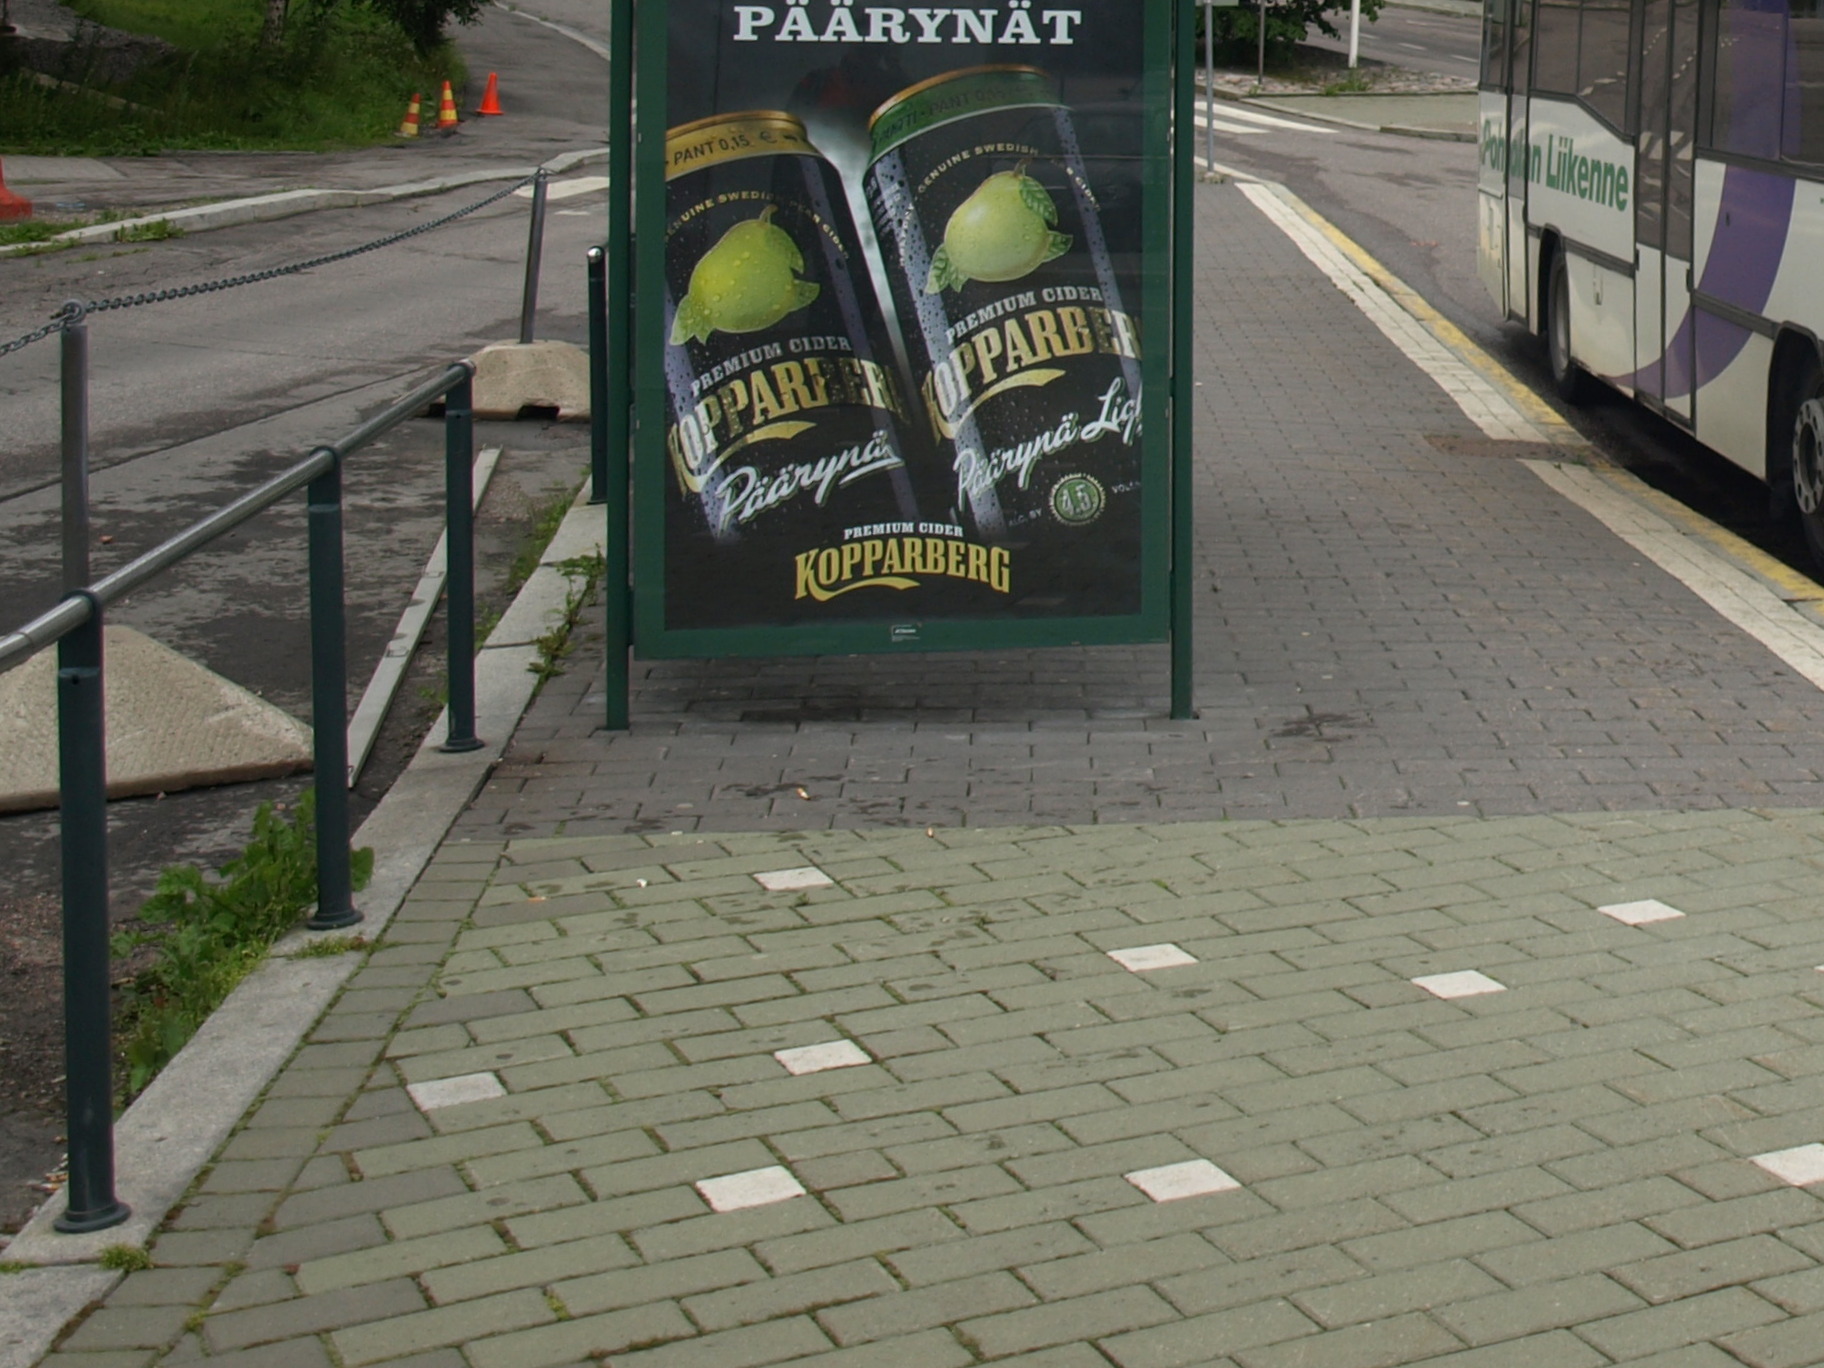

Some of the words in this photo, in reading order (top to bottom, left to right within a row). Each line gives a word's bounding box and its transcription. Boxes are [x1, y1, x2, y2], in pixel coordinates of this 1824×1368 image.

[674, 140, 715, 165] PANT
[918, 149, 971, 194] GENUINE
[974, 143, 1039, 156] SWEDISH
[1546, 134, 1629, 212] Liikenne
[717, 190, 784, 204] SWEDIS
[945, 290, 1037, 345] PREMIUM
[1041, 285, 1103, 303] CIDER
[691, 341, 783, 397] PREMIUM
[788, 335, 852, 354] CIDER
[714, 430, 904, 537] Päärynä
[953, 413, 1080, 512] Päärynä
[844, 522, 914, 540] PREMIUM
[919, 522, 963, 538] CIDER
[794, 537, 1010, 601] KOPPARBERG
